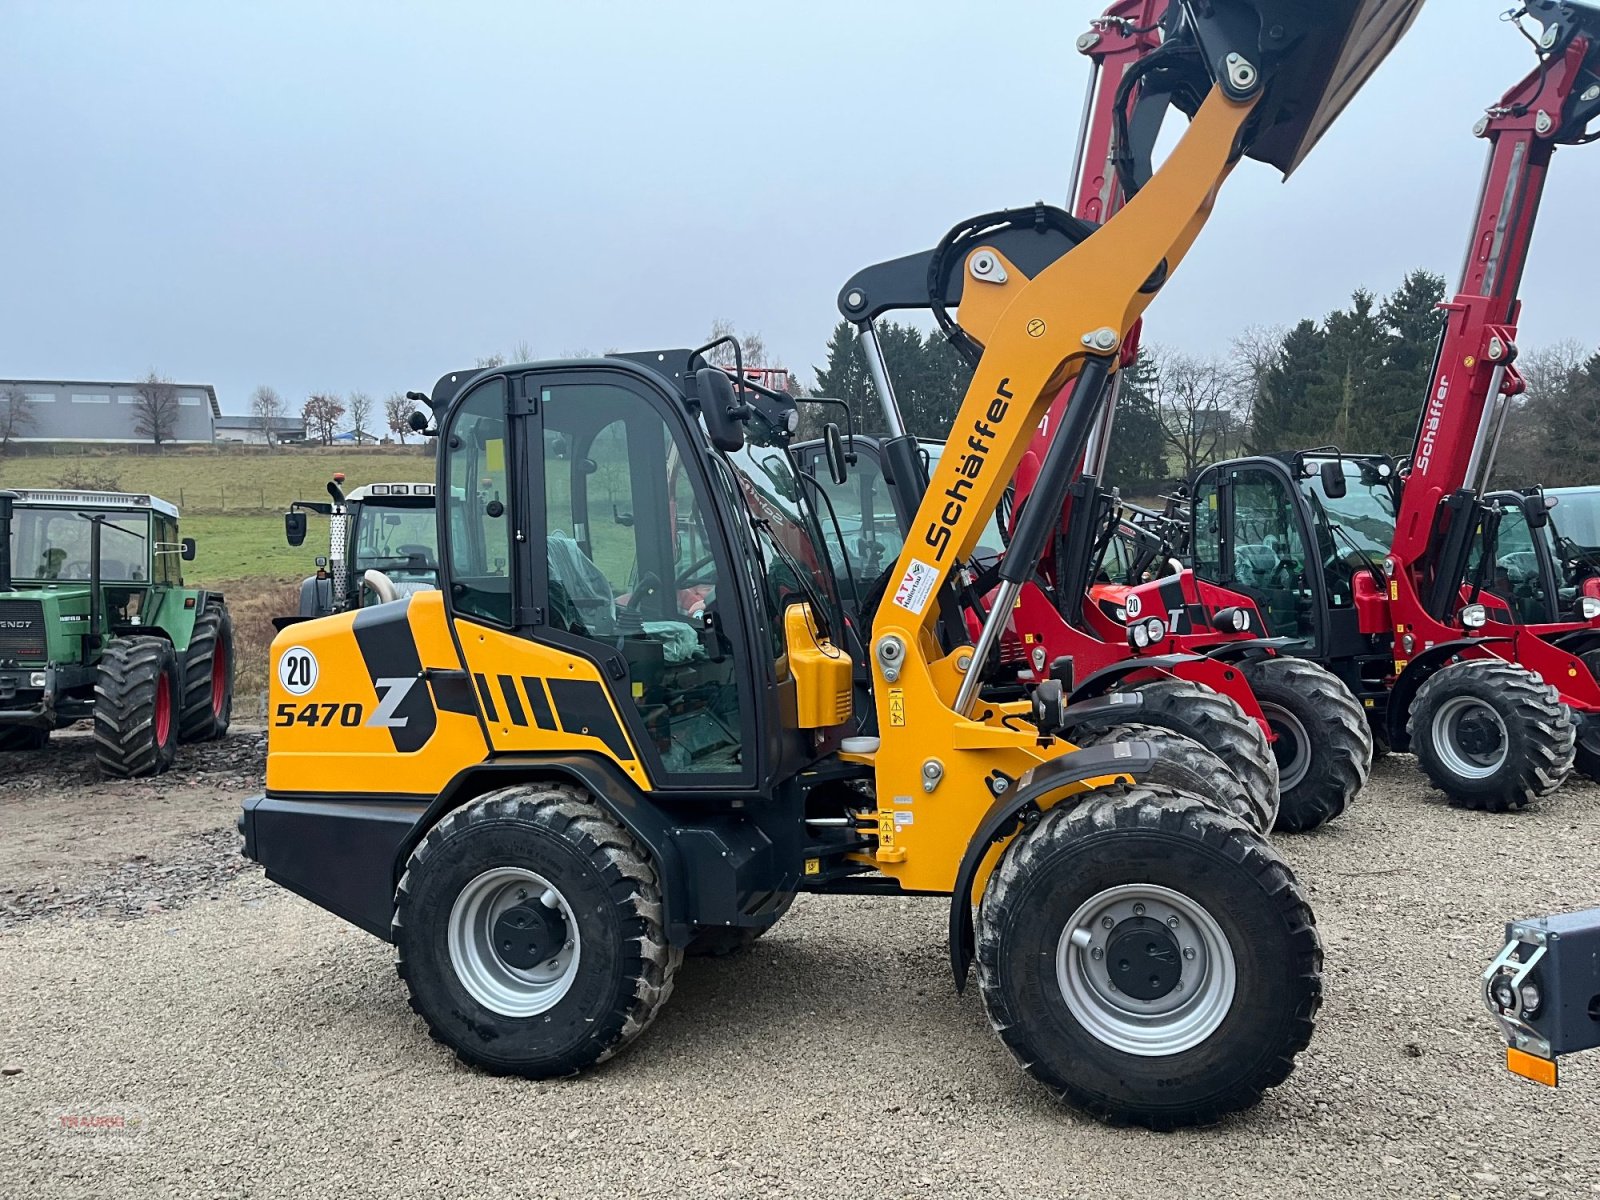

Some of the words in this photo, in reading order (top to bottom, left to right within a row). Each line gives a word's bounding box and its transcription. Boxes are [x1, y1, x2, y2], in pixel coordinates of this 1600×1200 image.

[1416, 374, 1449, 476] Schäffer
[925, 377, 1014, 562] Schäffer
[902, 576, 922, 608] Hallertau
[1128, 599, 1139, 613] 20
[0, 620, 32, 628] ENDT
[287, 656, 311, 686] 20
[275, 703, 363, 727] 5470
